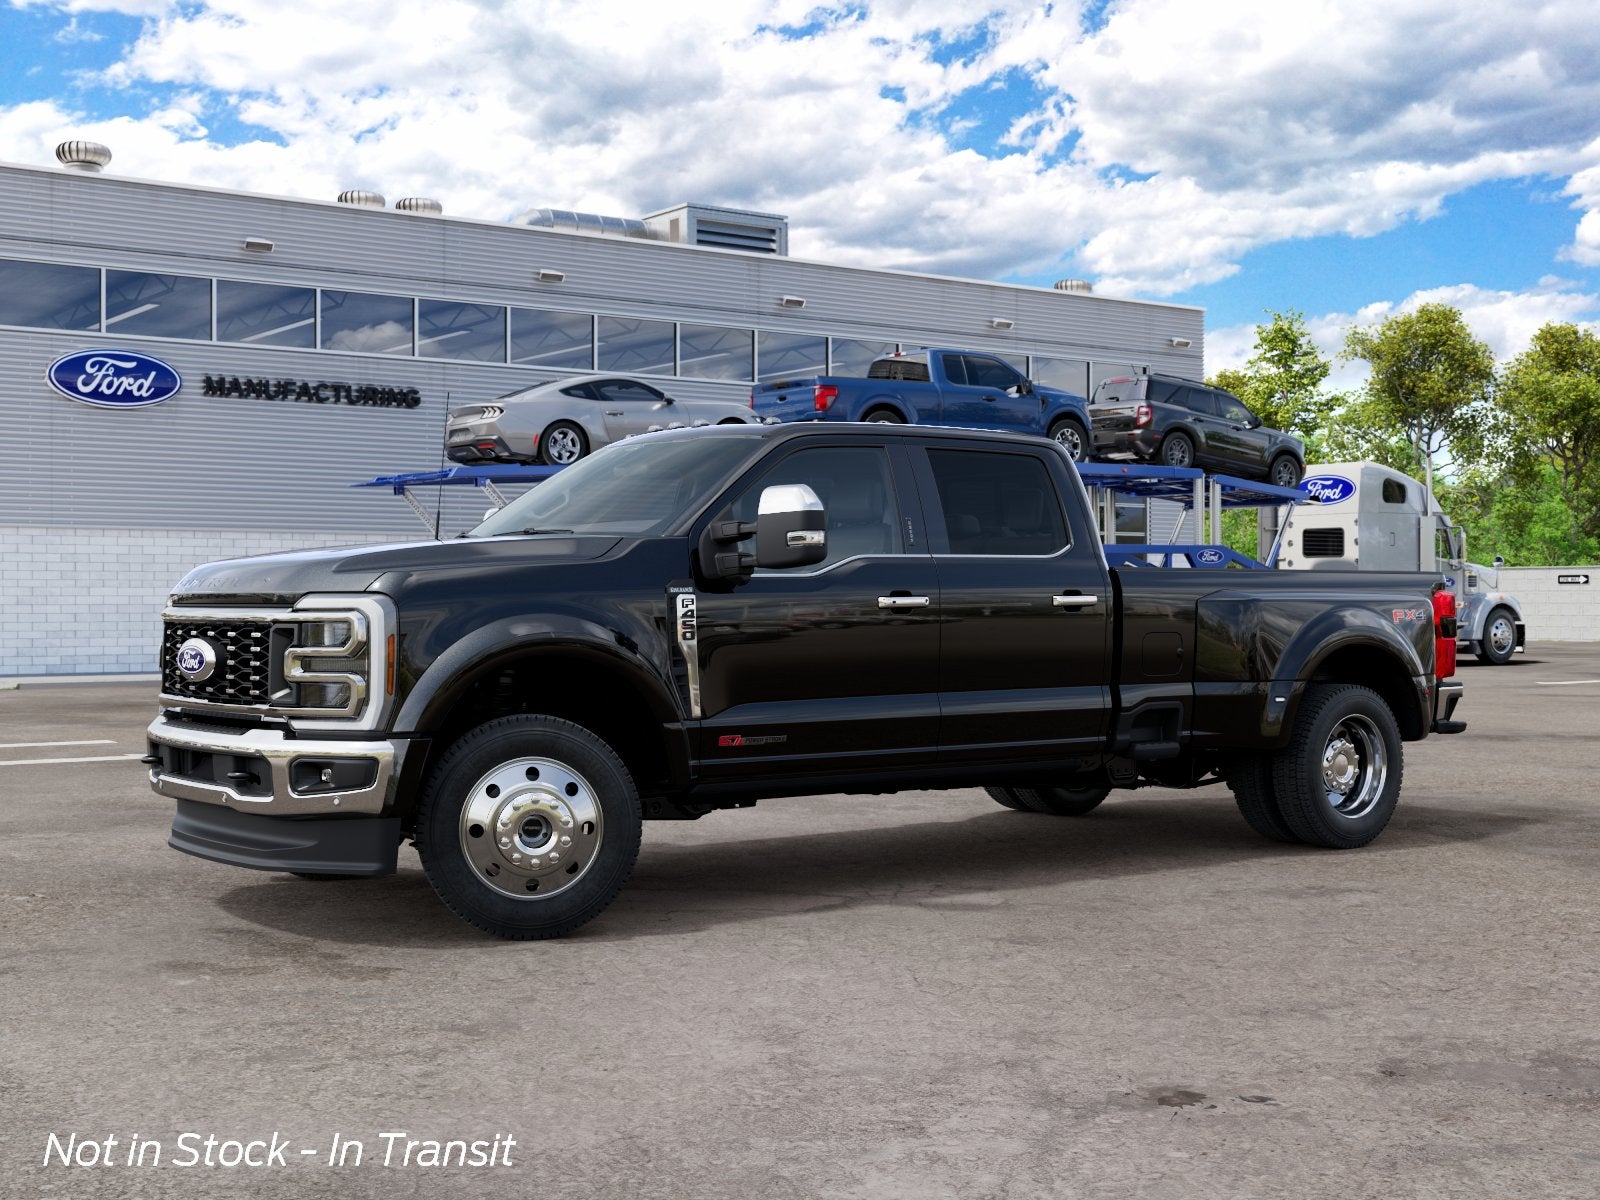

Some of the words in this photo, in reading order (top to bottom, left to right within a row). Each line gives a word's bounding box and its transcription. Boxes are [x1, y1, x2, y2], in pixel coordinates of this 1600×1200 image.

[77, 357, 155, 397] Ford
[202, 373, 421, 409] MANUFACTURING
[1307, 480, 1343, 500] Ford
[1201, 551, 1219, 561] Ford
[1392, 609, 1426, 623] FX4
[182, 649, 200, 669] Ford
